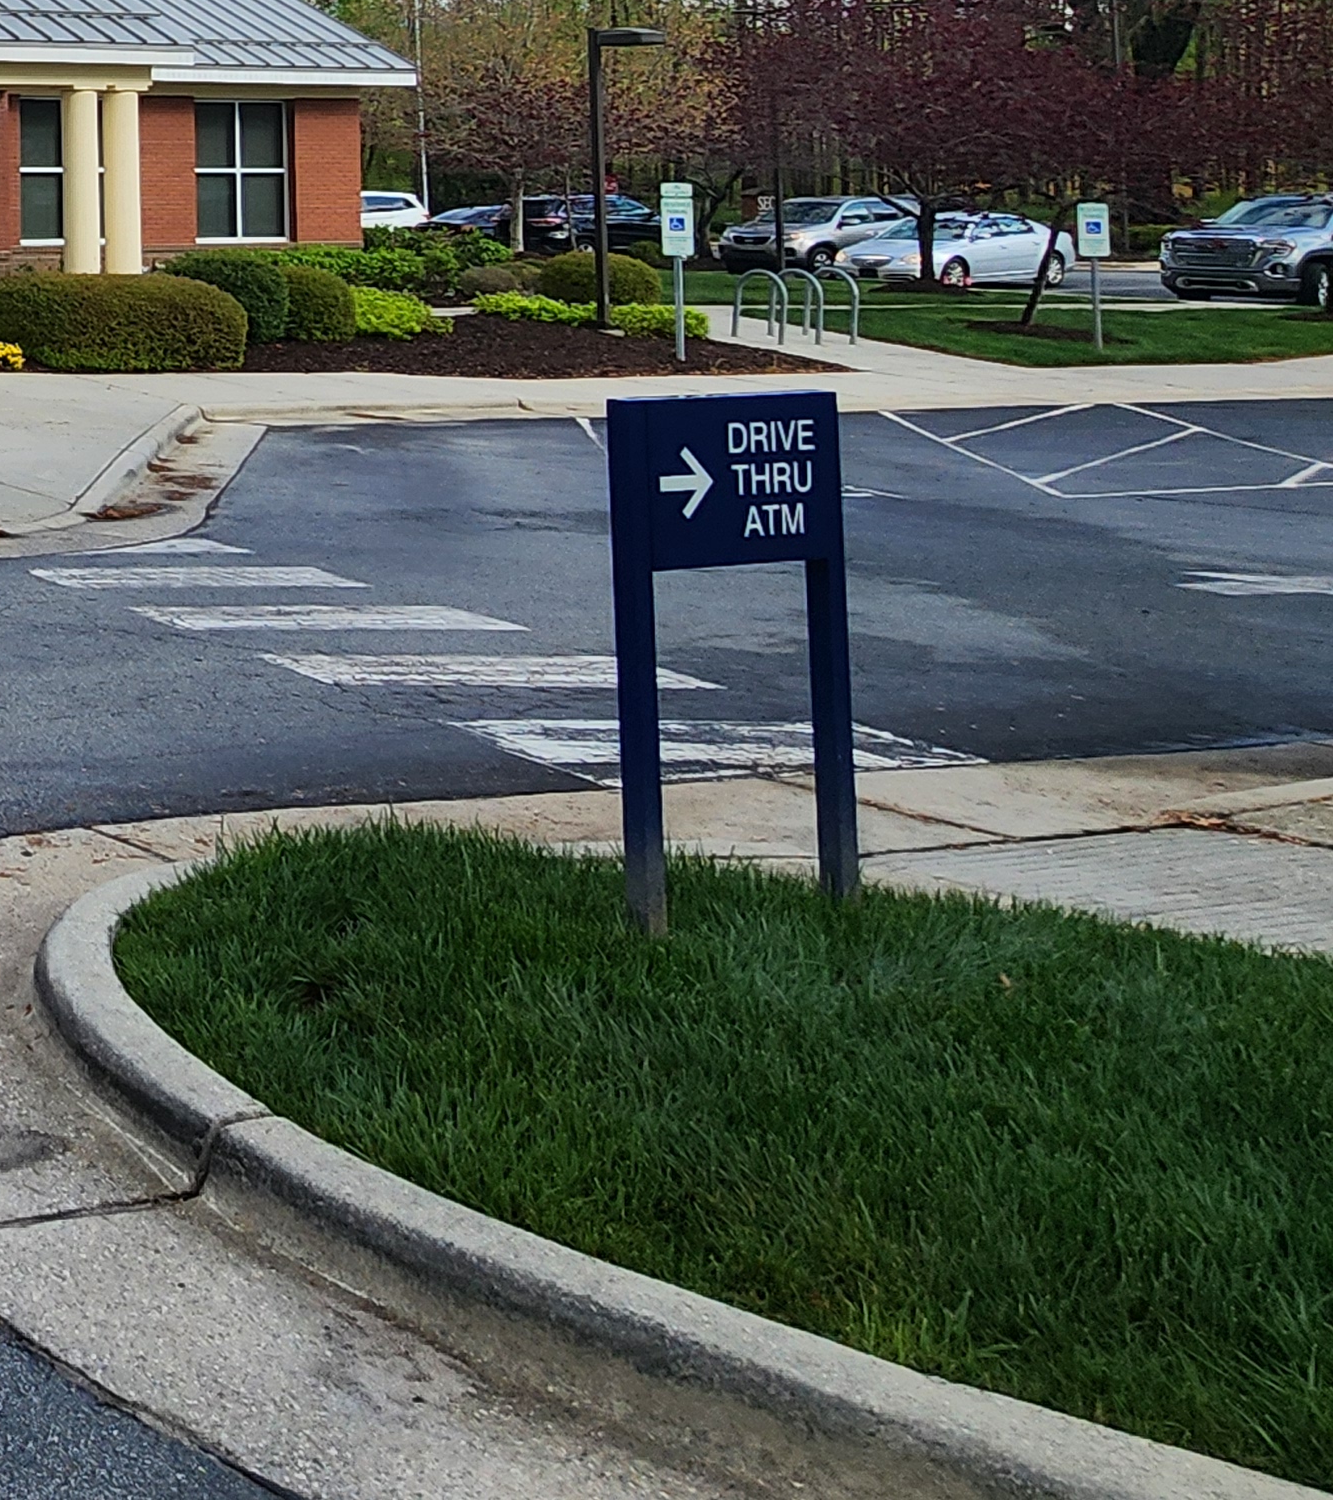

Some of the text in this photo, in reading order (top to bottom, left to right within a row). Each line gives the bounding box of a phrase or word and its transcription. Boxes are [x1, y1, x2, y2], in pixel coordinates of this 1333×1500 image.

[757, 195, 777, 211] SEC
[727, 419, 816, 454] DRIVE
[731, 460, 812, 496] THRU
[743, 502, 806, 538] ATM
